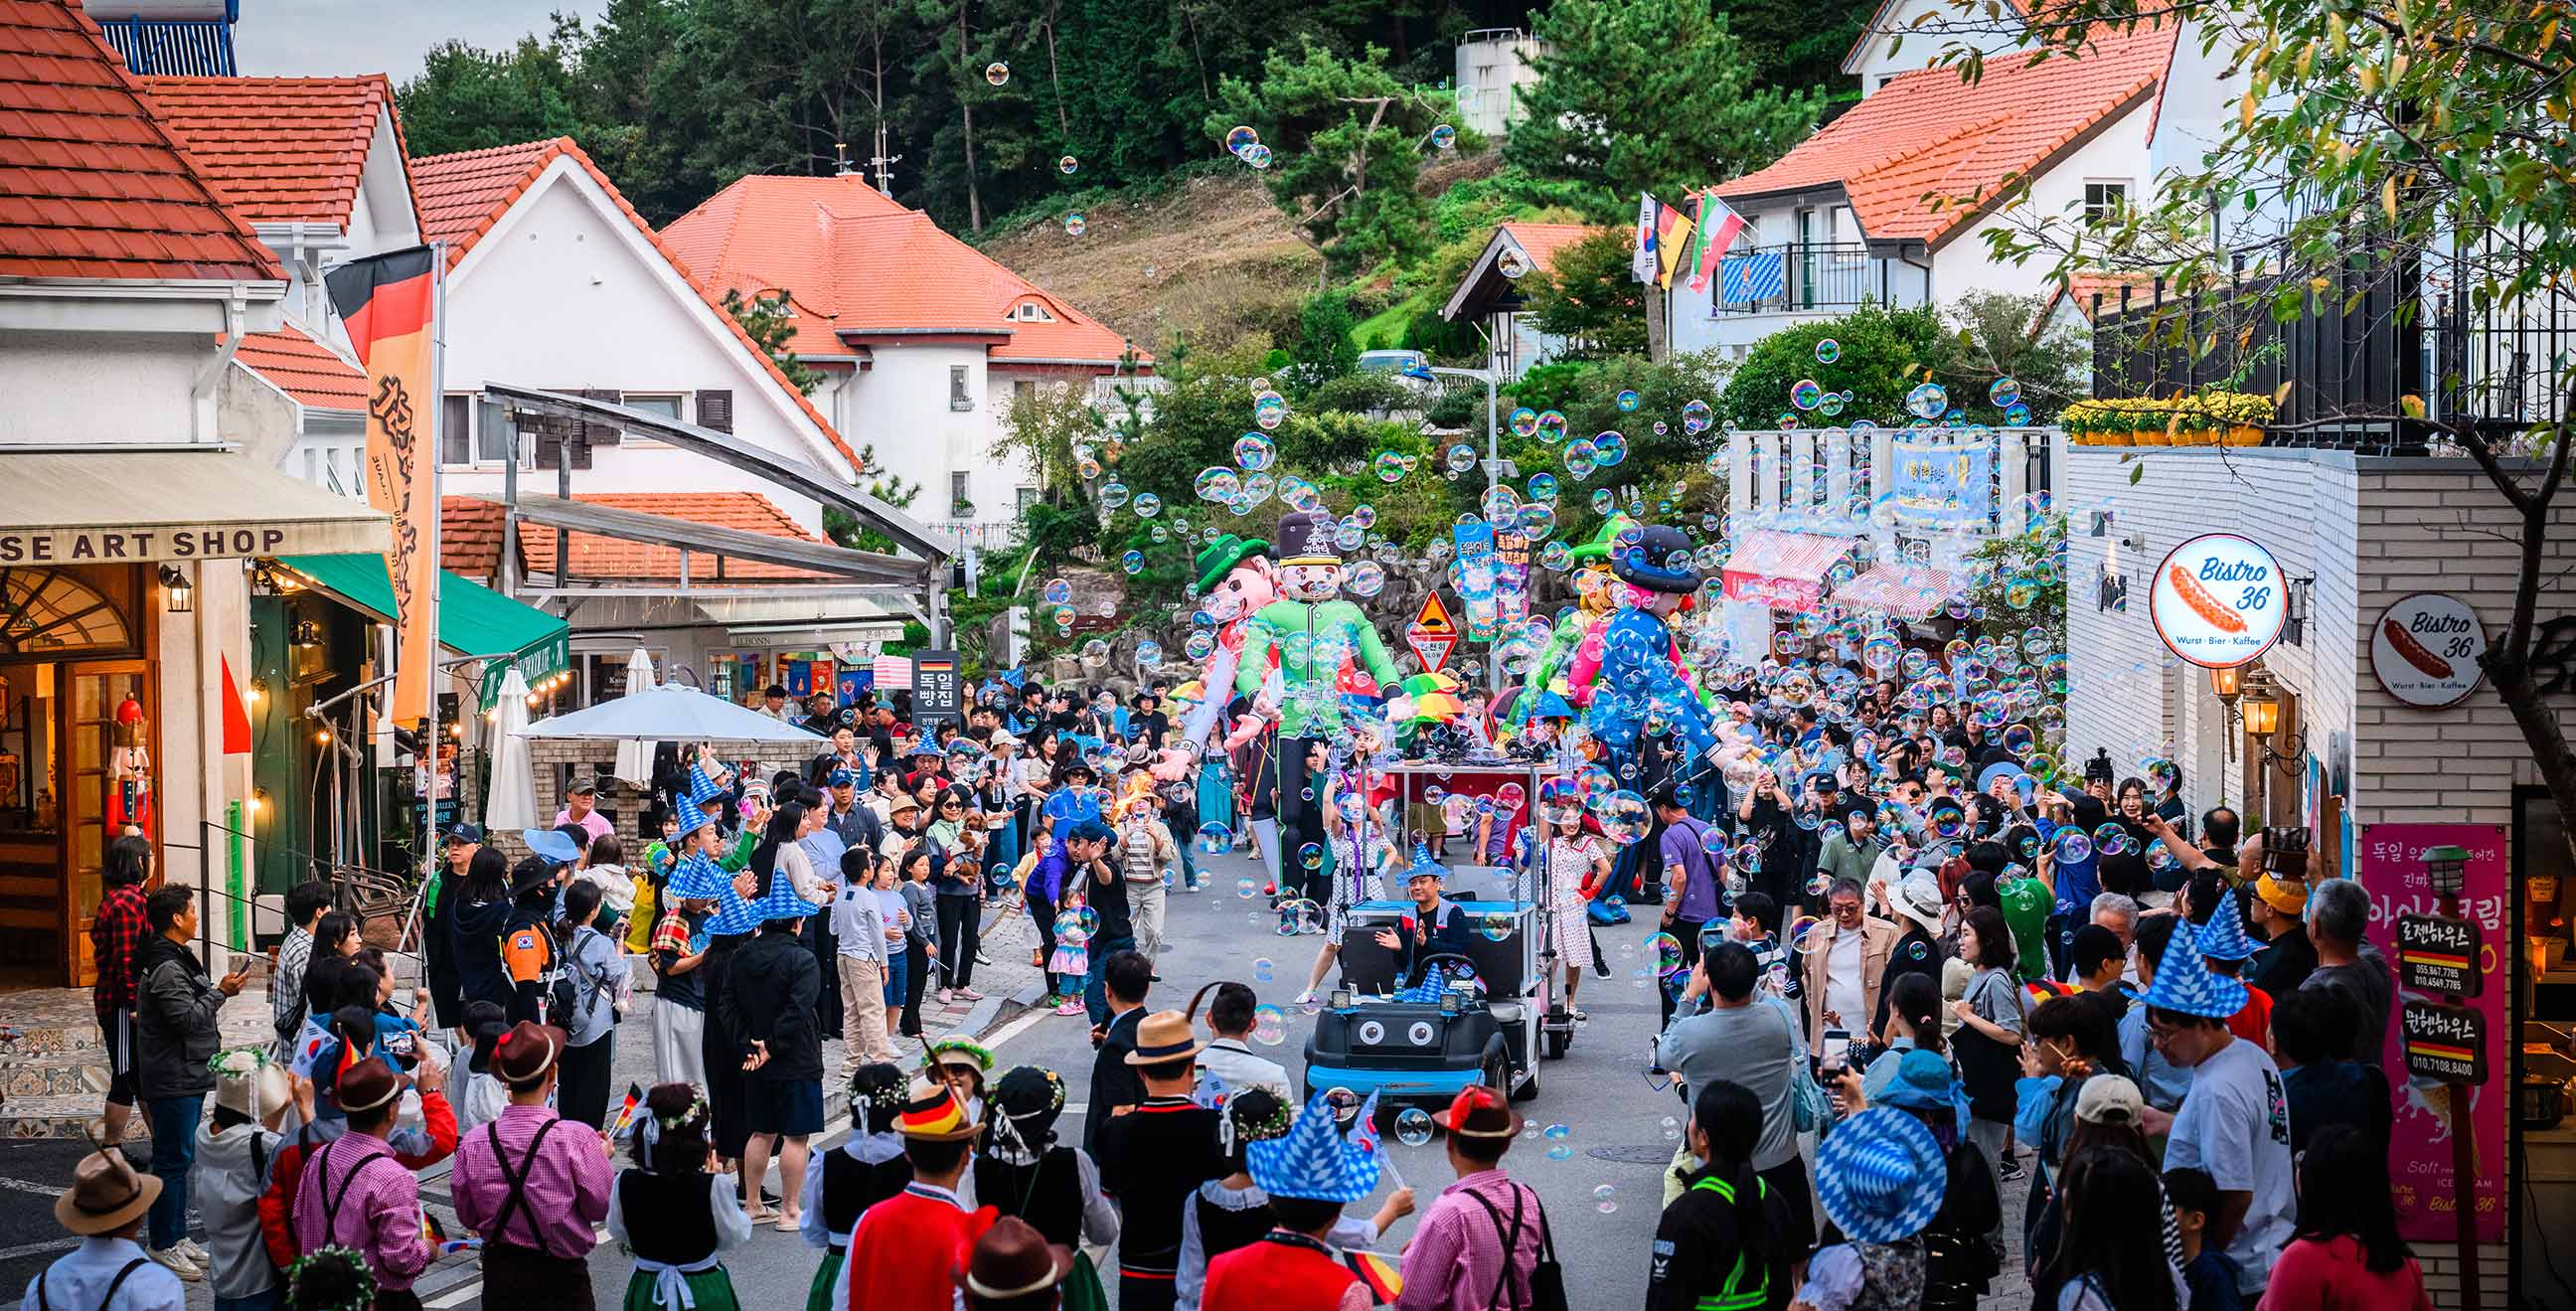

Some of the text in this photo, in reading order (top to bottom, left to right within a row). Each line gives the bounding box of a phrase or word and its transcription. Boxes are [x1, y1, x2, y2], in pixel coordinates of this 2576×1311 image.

[72, 533, 154, 559] ART
[173, 530, 284, 557] SHOP
[2199, 557, 2268, 581] Bistro
[2236, 586, 2271, 610] 36
[2411, 611, 2471, 633] Bistro
[2176, 636, 2261, 645] Wurst Bier Kaffee
[2443, 637, 2475, 658] 36
[920, 674, 952, 690] 독일
[919, 691, 953, 707] 빵집
[2372, 842, 2403, 863] 독일
[2401, 920, 2470, 948] 로젠하우스
[2406, 1008, 2476, 1040] 뮌헨하우스
[2413, 1056, 2473, 1075] 010.7108.8400
[2429, 1196, 2457, 1212] Bist
